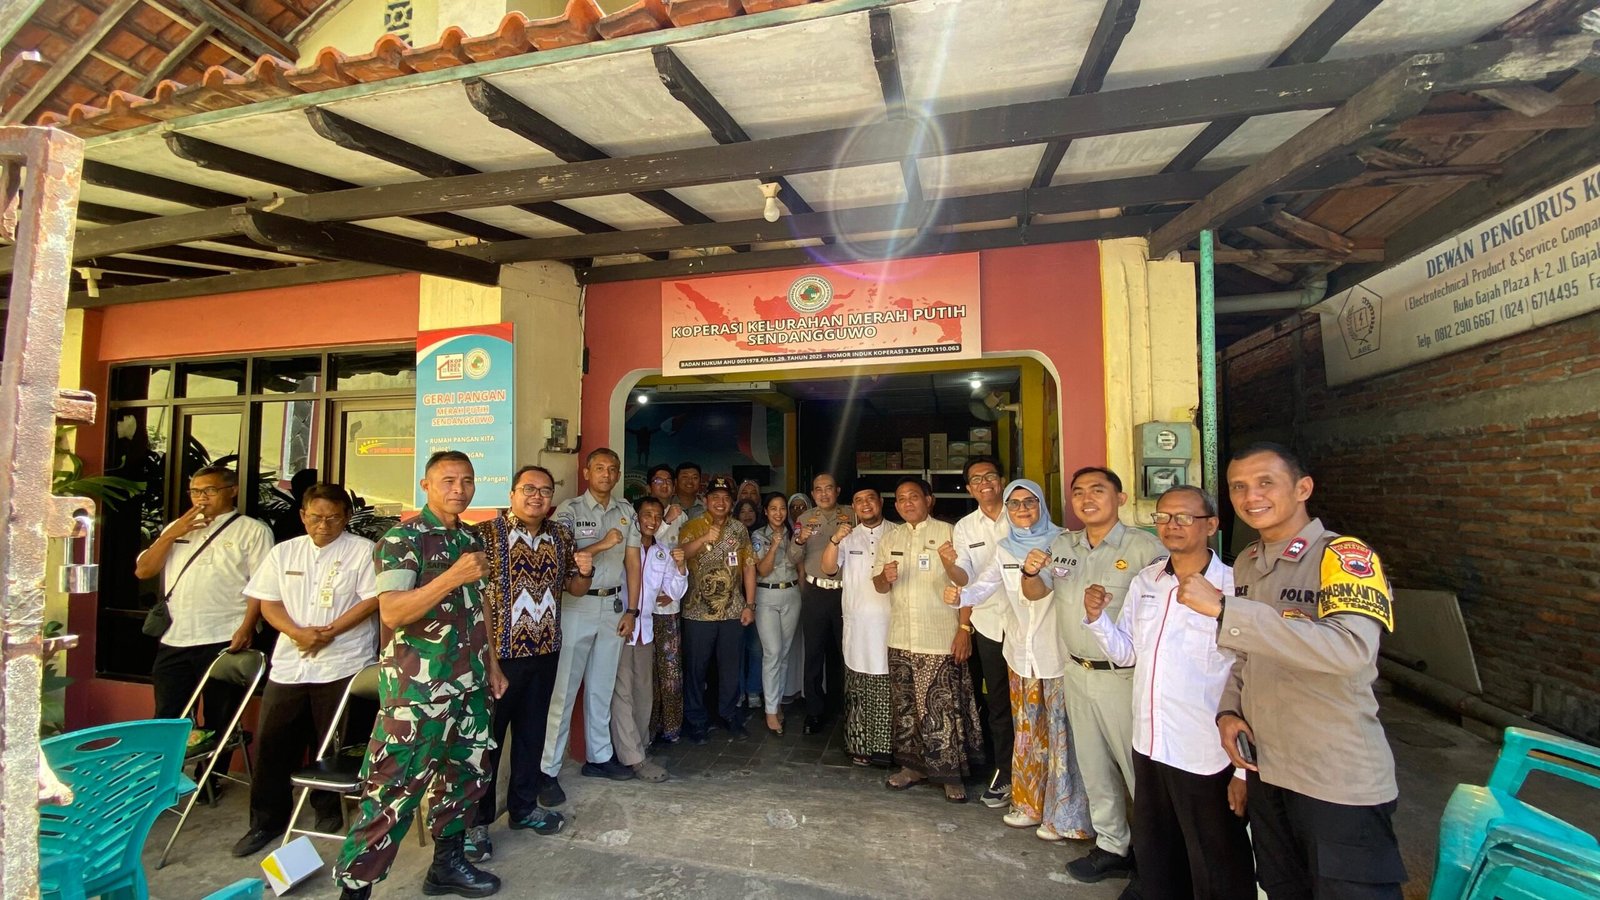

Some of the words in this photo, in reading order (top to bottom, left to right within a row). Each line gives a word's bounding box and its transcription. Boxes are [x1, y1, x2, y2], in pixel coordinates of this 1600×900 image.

[1426, 239, 1474, 278] DEWAN
[1479, 187, 1577, 252] PENGURUS
[1582, 171, 1600, 203] K
[1471, 258, 1506, 283] Product
[1509, 251, 1518, 266] &
[1518, 237, 1558, 262] Service
[1453, 296, 1473, 313] Ruko
[1475, 283, 1501, 305] Gajah
[1503, 276, 1529, 295] Plaza
[1500, 297, 1529, 321] (024)
[1531, 279, 1579, 310] 6714495
[672, 322, 743, 338] KOPERASI
[747, 315, 843, 333] KELURAHAN
[847, 309, 908, 325] MERAH
[913, 305, 966, 321] PUTIH
[747, 326, 877, 346] SENDANGGUWO
[873, 349, 904, 357] KOPERASI
[423, 392, 455, 405] GERAI
[457, 389, 506, 403] PANGAN
[436, 406, 464, 416] MERAH
[465, 404, 489, 415] PUTIH
[432, 414, 495, 427] SENDANGGUWO
[1053, 556, 1077, 566] ARIS
